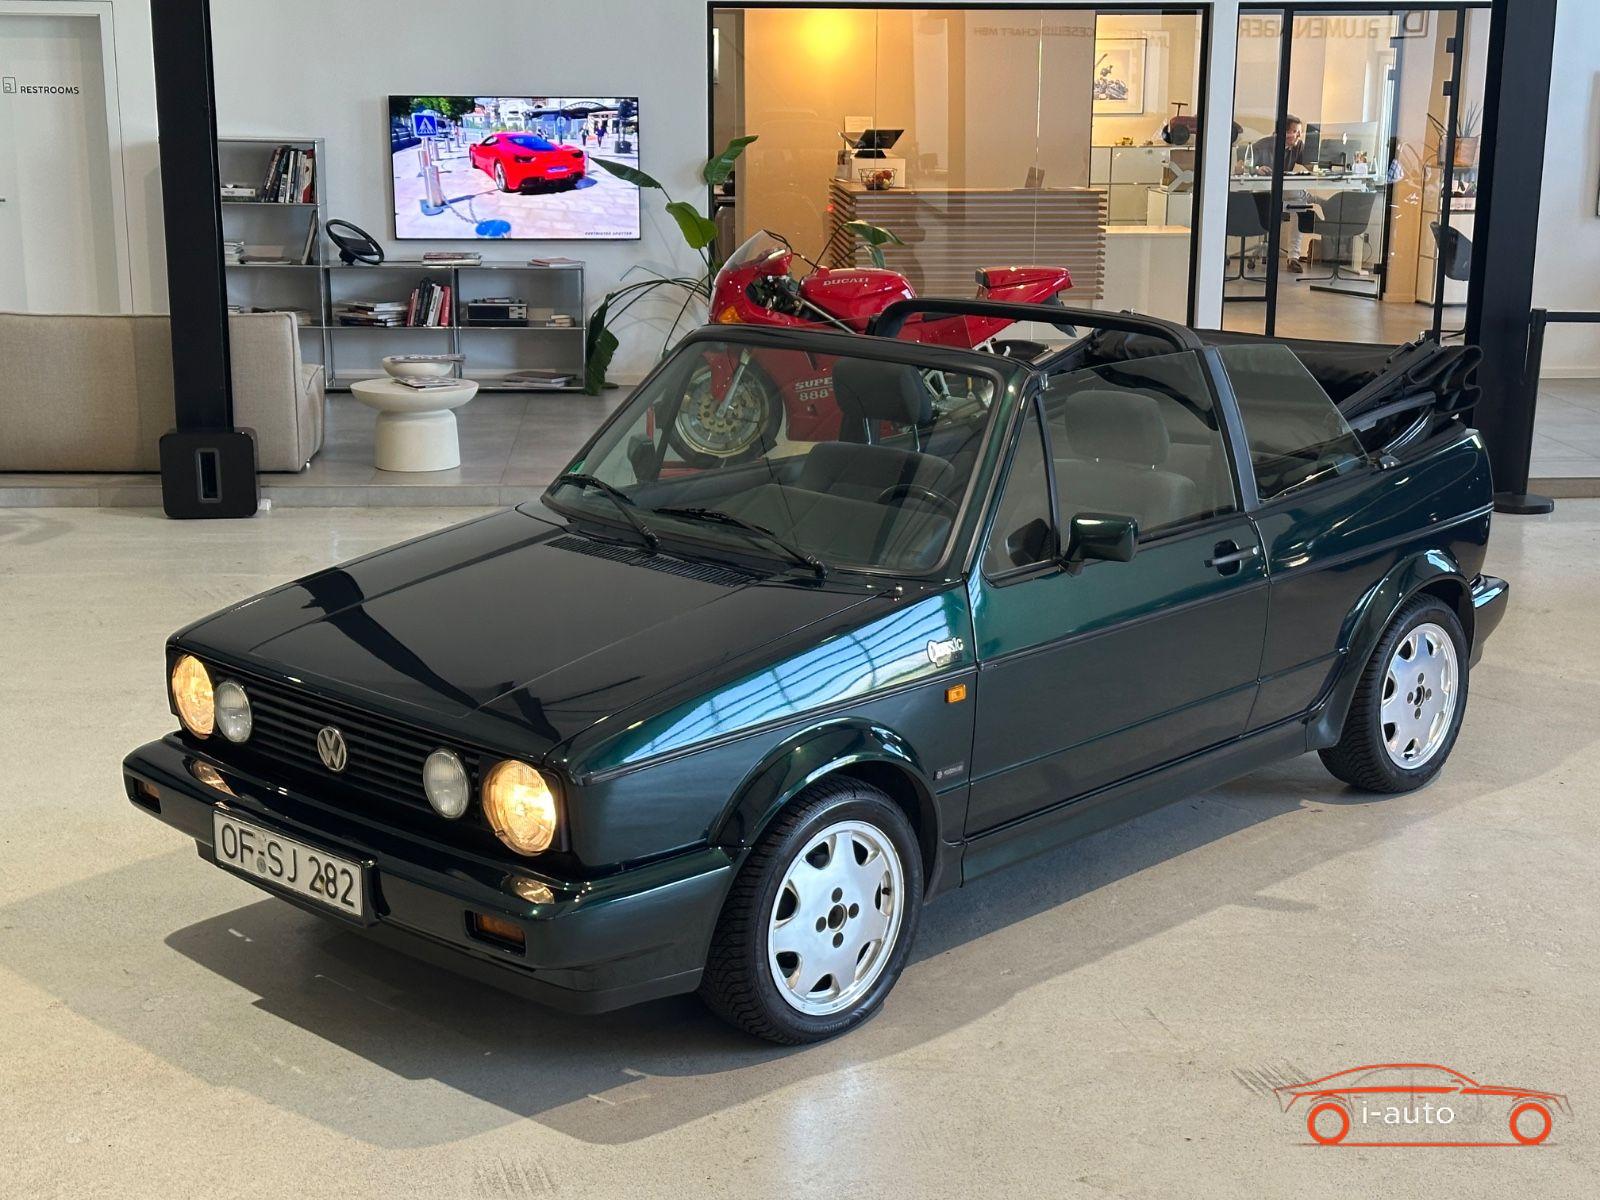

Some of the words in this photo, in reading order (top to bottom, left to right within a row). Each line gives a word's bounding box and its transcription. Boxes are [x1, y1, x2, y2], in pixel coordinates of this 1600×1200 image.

[20, 85, 80, 95] RESTROOMS
[823, 277, 869, 286] DUCATI
[800, 389, 829, 401] 888
[308, 855, 355, 908] 282
